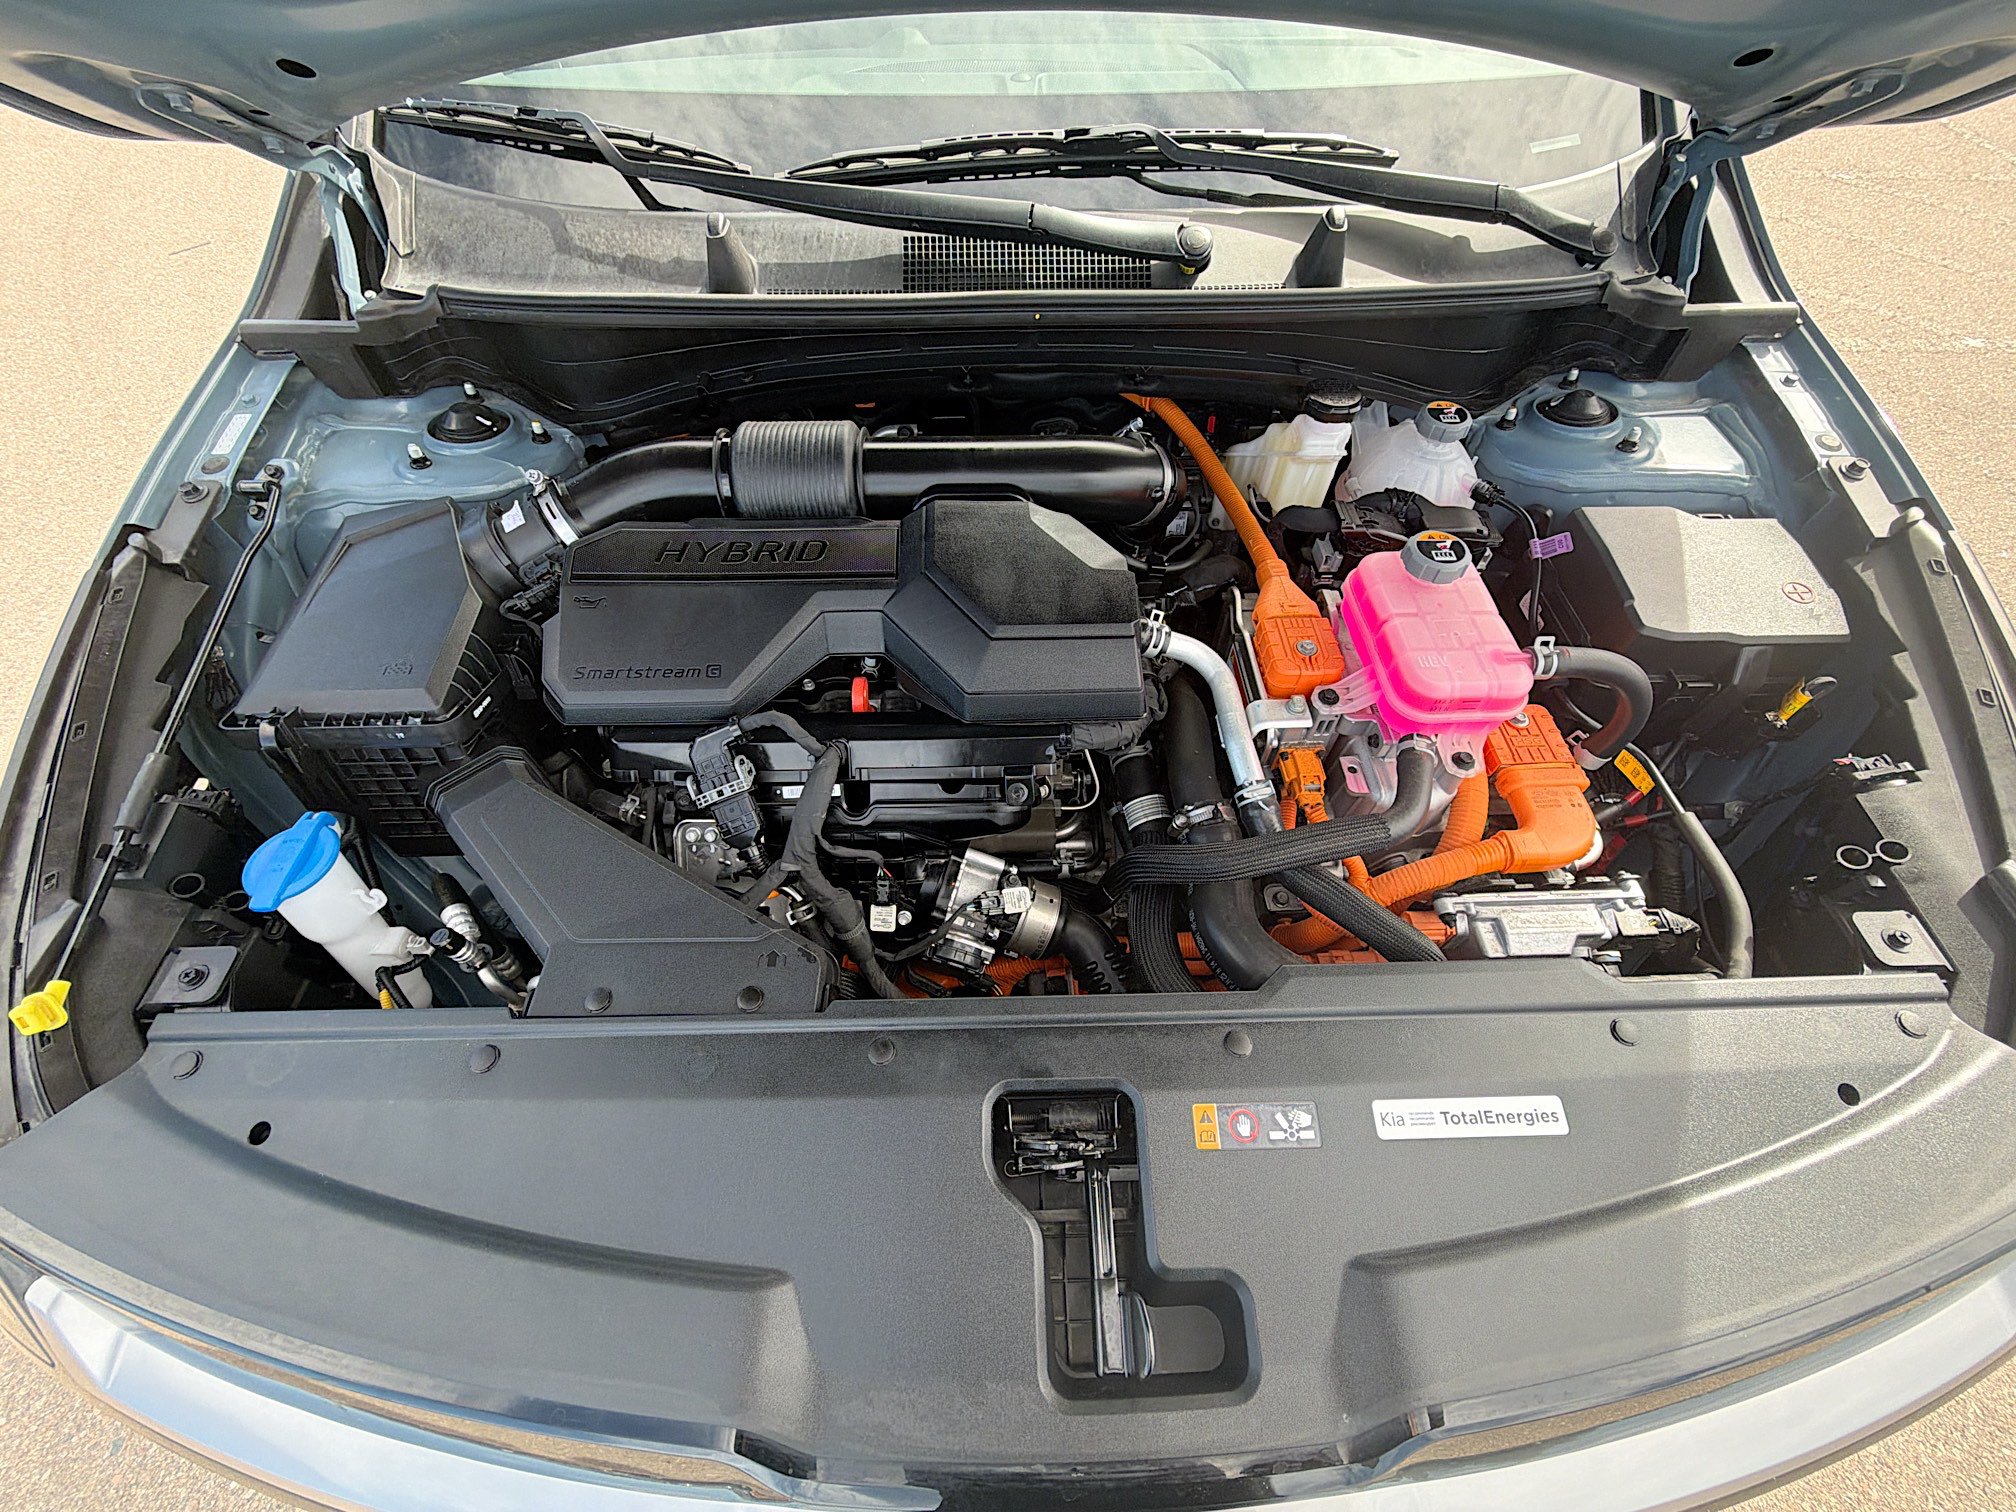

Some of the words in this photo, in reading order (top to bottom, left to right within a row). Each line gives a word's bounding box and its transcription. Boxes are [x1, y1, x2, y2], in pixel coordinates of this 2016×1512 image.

[655, 540, 829, 564] HYBRID
[573, 665, 701, 680] Smartstream
[1380, 1111, 1405, 1127] Kia
[1440, 1108, 1560, 1126] TotalEnergies
